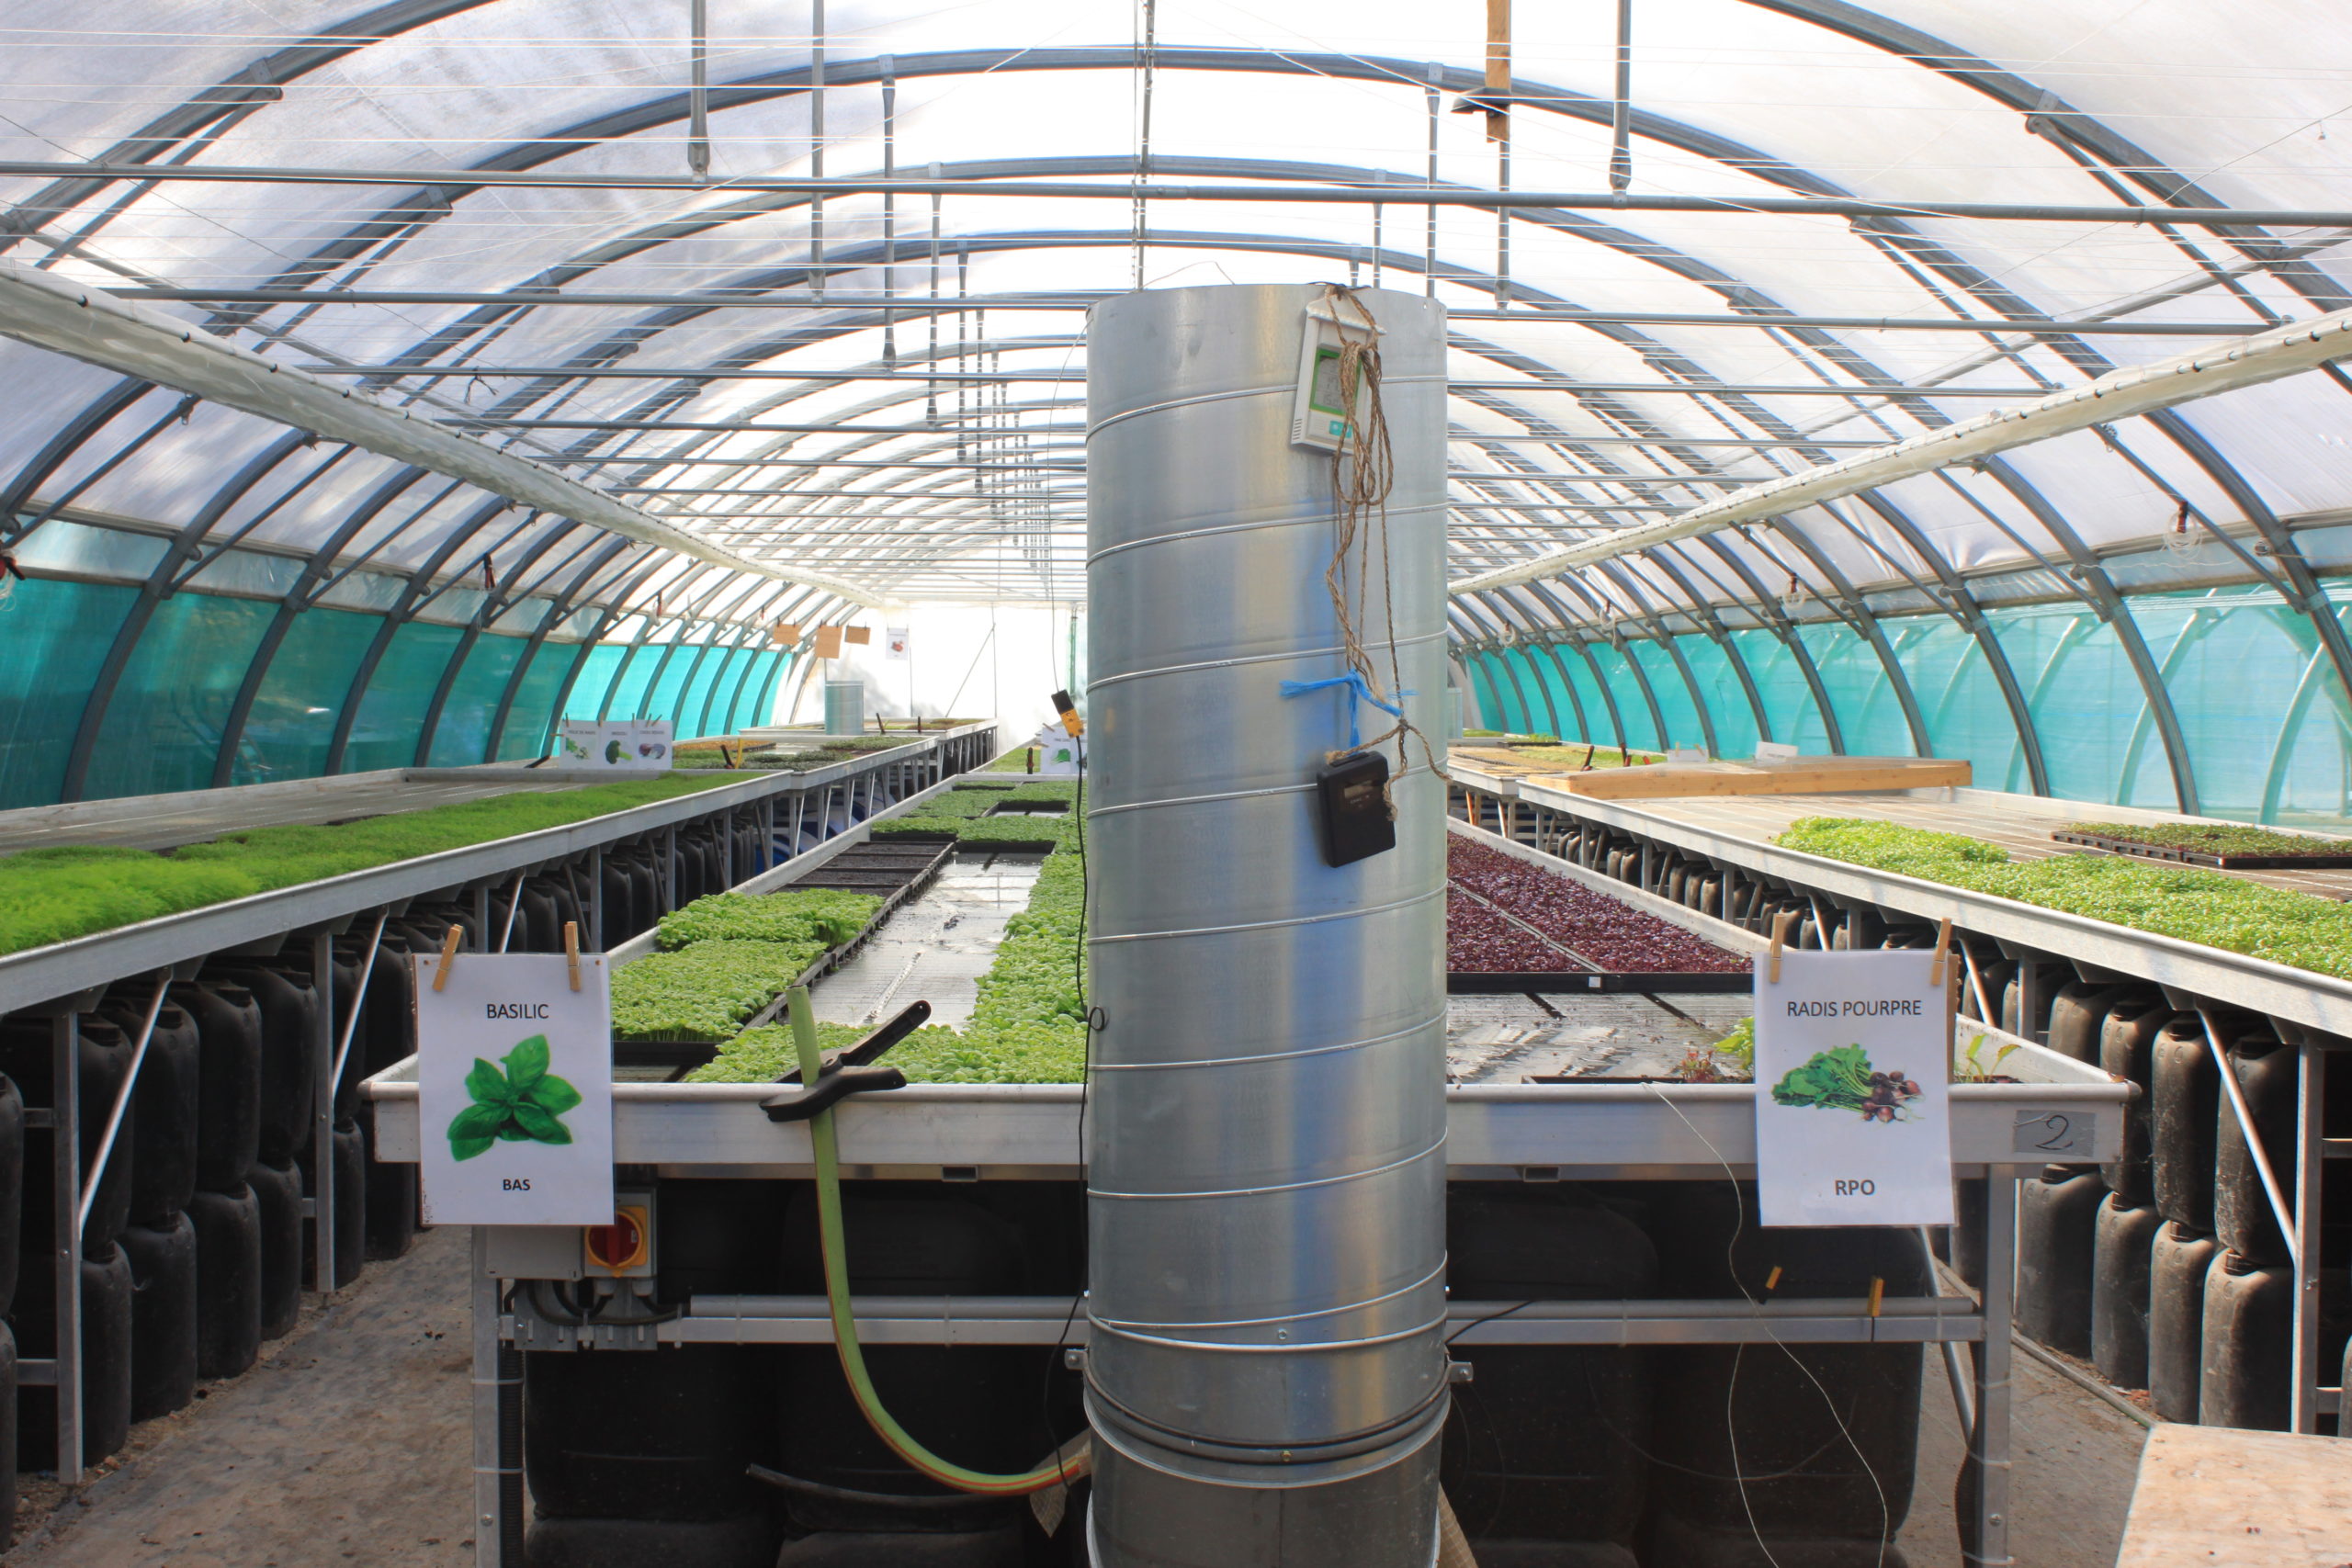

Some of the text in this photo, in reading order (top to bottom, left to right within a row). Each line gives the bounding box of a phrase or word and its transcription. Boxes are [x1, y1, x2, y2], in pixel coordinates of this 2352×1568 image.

[486, 1003, 549, 1020] BASILIC
[1787, 999, 1922, 1017] RADIS POURPRE
[2035, 1114, 2074, 1151] 2
[503, 1179, 531, 1191] BAS
[1835, 1179, 1875, 1196] RPO
